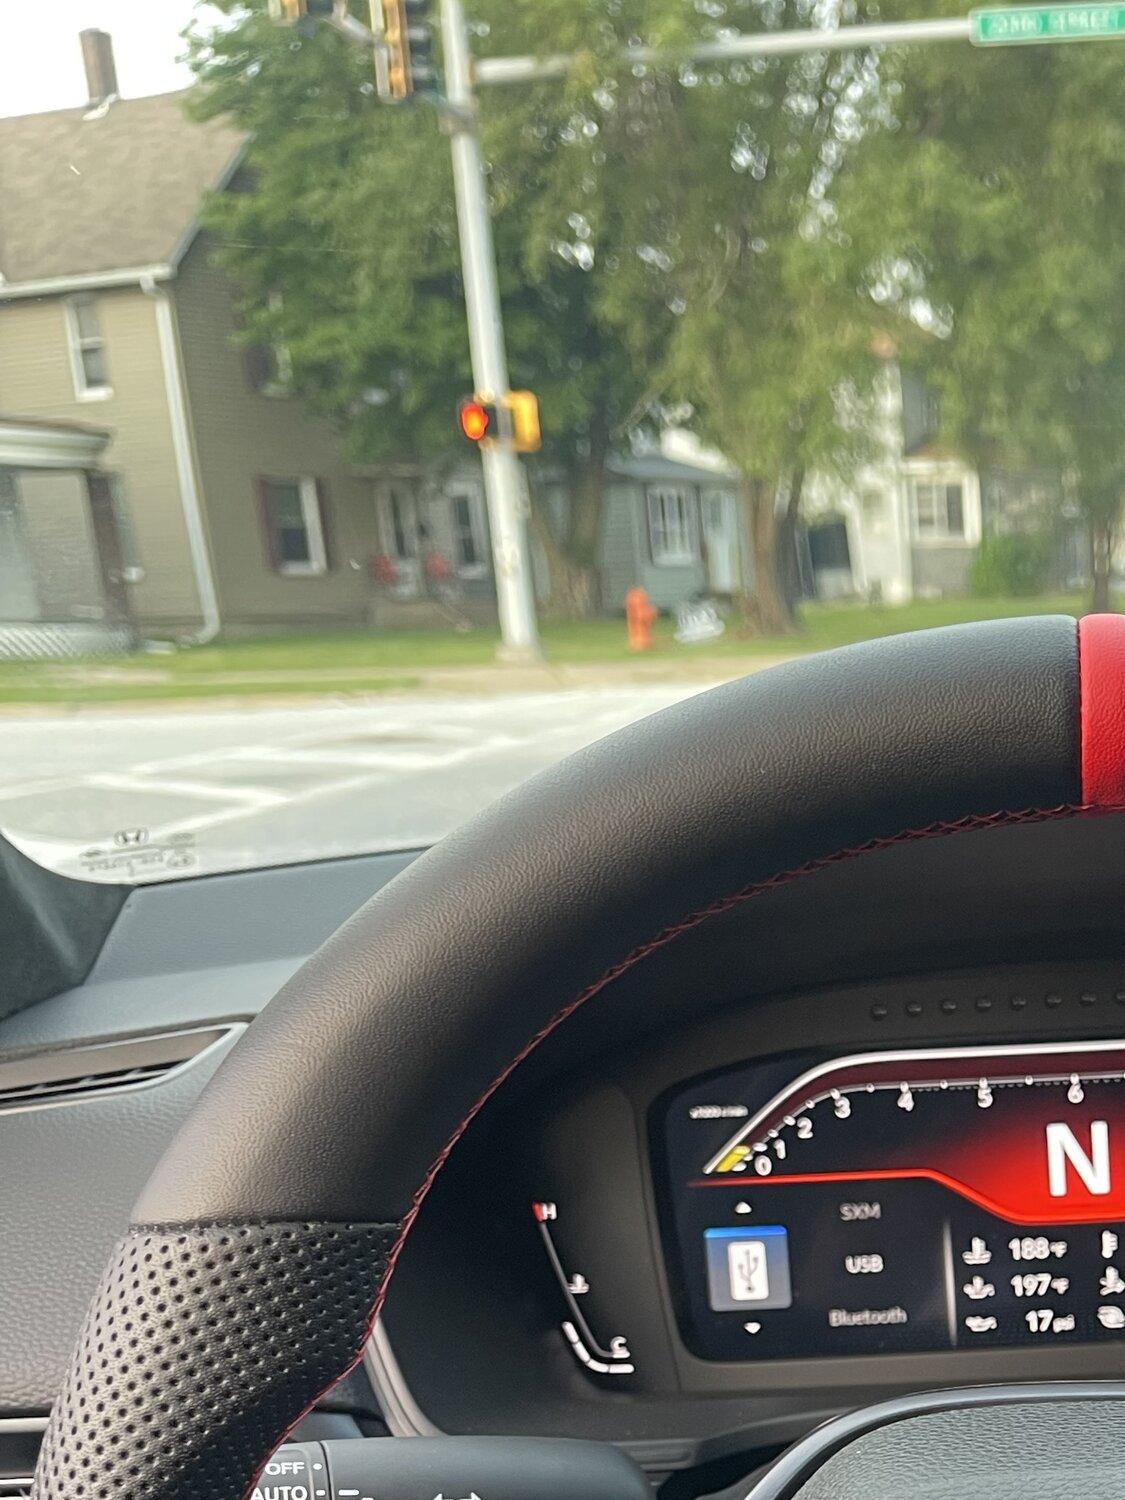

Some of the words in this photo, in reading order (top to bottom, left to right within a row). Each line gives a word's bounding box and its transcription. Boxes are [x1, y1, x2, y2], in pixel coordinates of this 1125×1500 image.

[897, 1093, 914, 1112] 4
[977, 1088, 994, 1108] 5
[1067, 1083, 1085, 1104] 6
[834, 1096, 851, 1119] 3
[797, 1116, 814, 1139] 2
[774, 1138, 787, 1160] 1
[1046, 1120, 1111, 1197] N
[754, 1154, 773, 1177] 0
[839, 1202, 881, 1221] SXM
[845, 1253, 884, 1275] USB
[829, 1306, 908, 1329] Bluetooth
[264, 1460, 306, 1477] OFF
